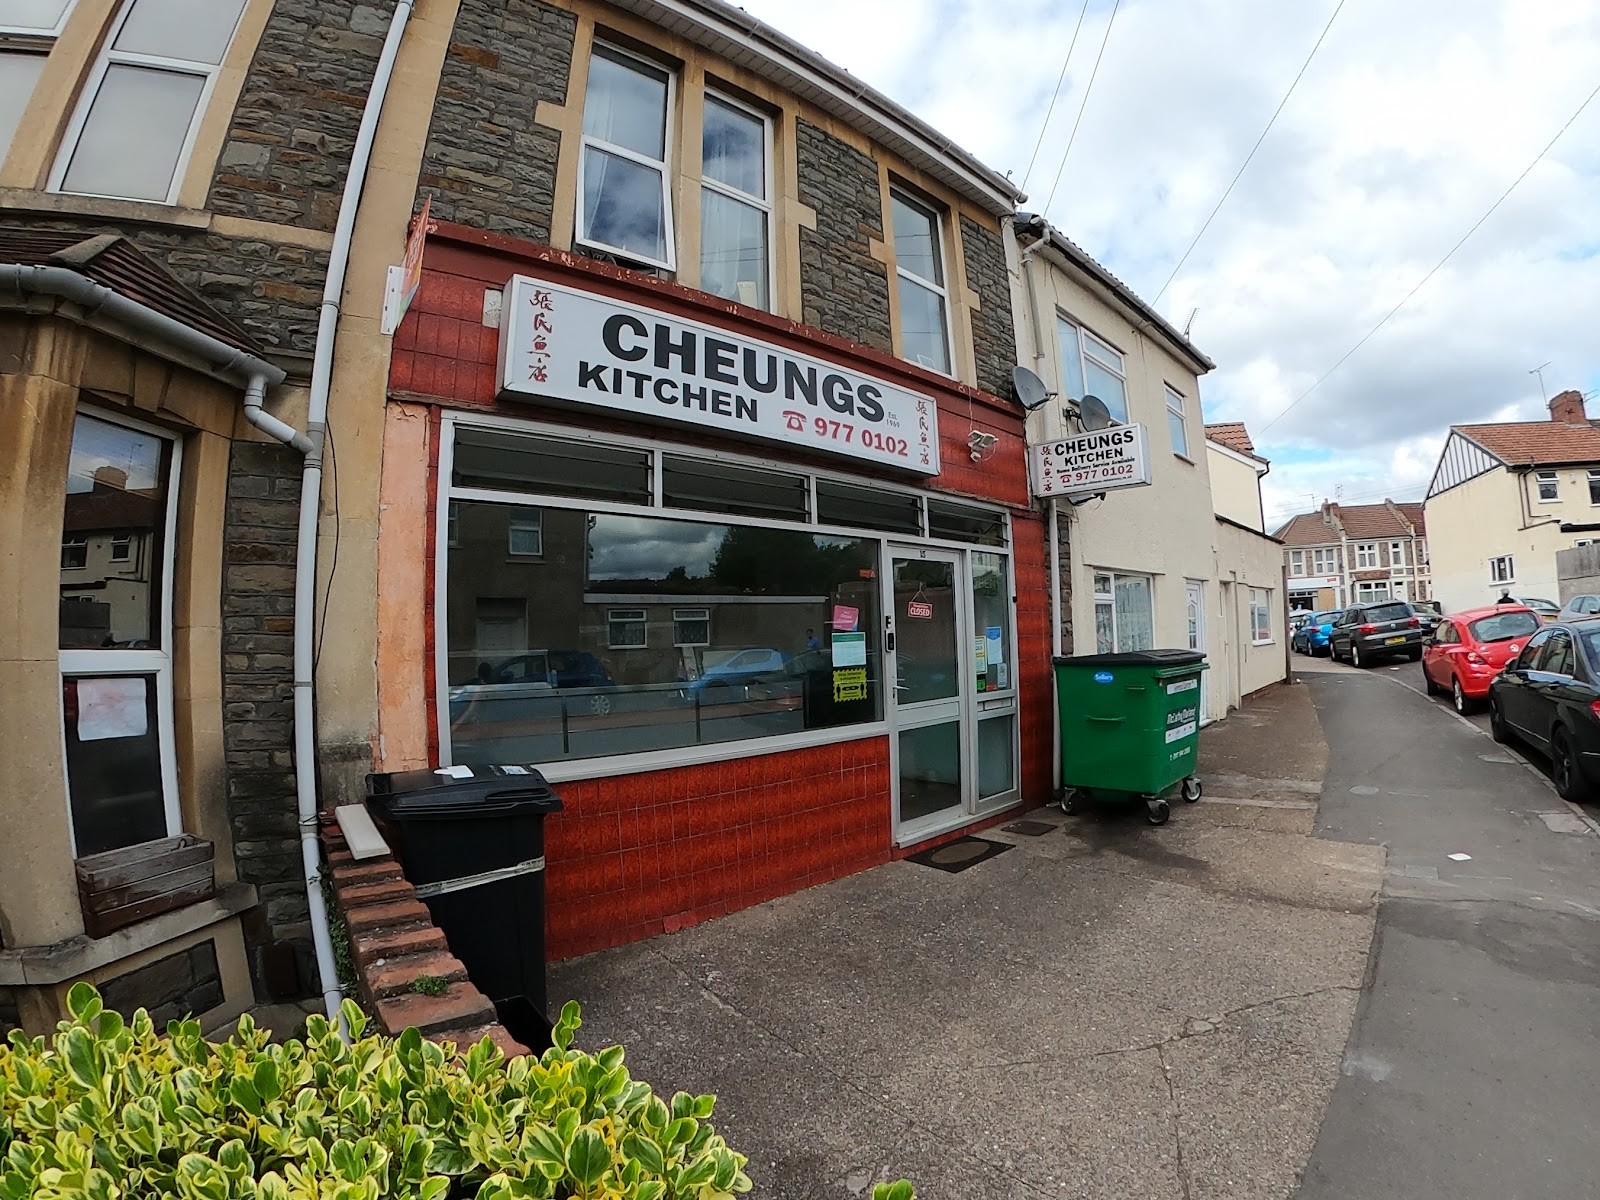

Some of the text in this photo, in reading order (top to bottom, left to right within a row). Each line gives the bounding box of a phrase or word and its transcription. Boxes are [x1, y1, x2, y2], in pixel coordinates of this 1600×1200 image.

[602, 313, 885, 423] CHEUNGS
[578, 360, 758, 423] KITCHEN
[814, 417, 908, 457] 977 0102
[1054, 430, 1134, 456] CHEUNGS
[1064, 447, 1123, 467] KITCHEN
[1075, 464, 1133, 481] 977 0102
[910, 607, 930, 617] CLOSED
